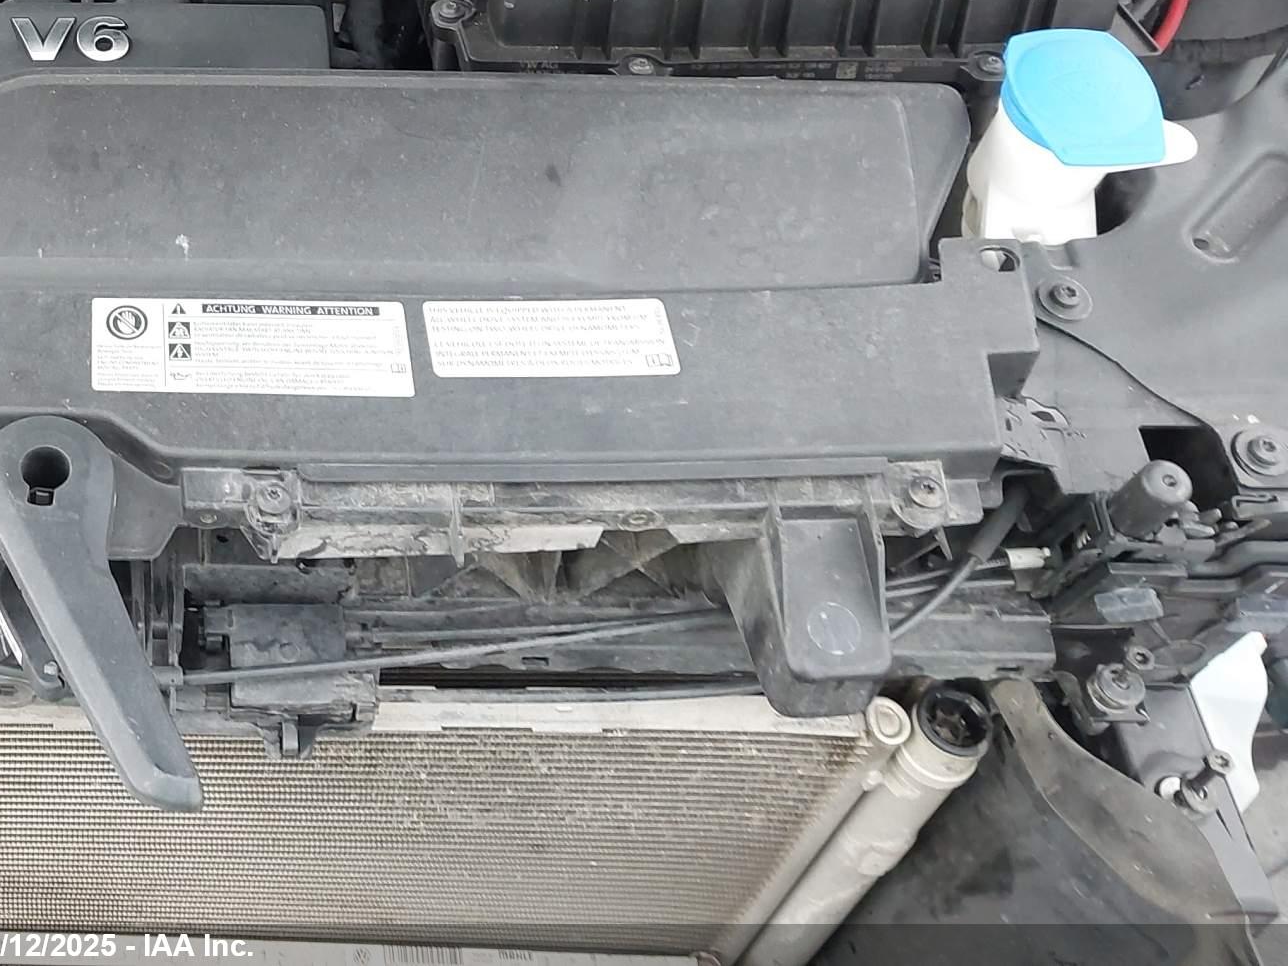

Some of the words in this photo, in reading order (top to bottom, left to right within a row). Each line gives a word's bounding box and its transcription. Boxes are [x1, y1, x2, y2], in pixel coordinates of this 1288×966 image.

[11, 17, 130, 62] V6
[205, 304, 256, 314] ACHTUNG
[262, 305, 312, 315] WARNING
[316, 306, 373, 316] ATTENTION
